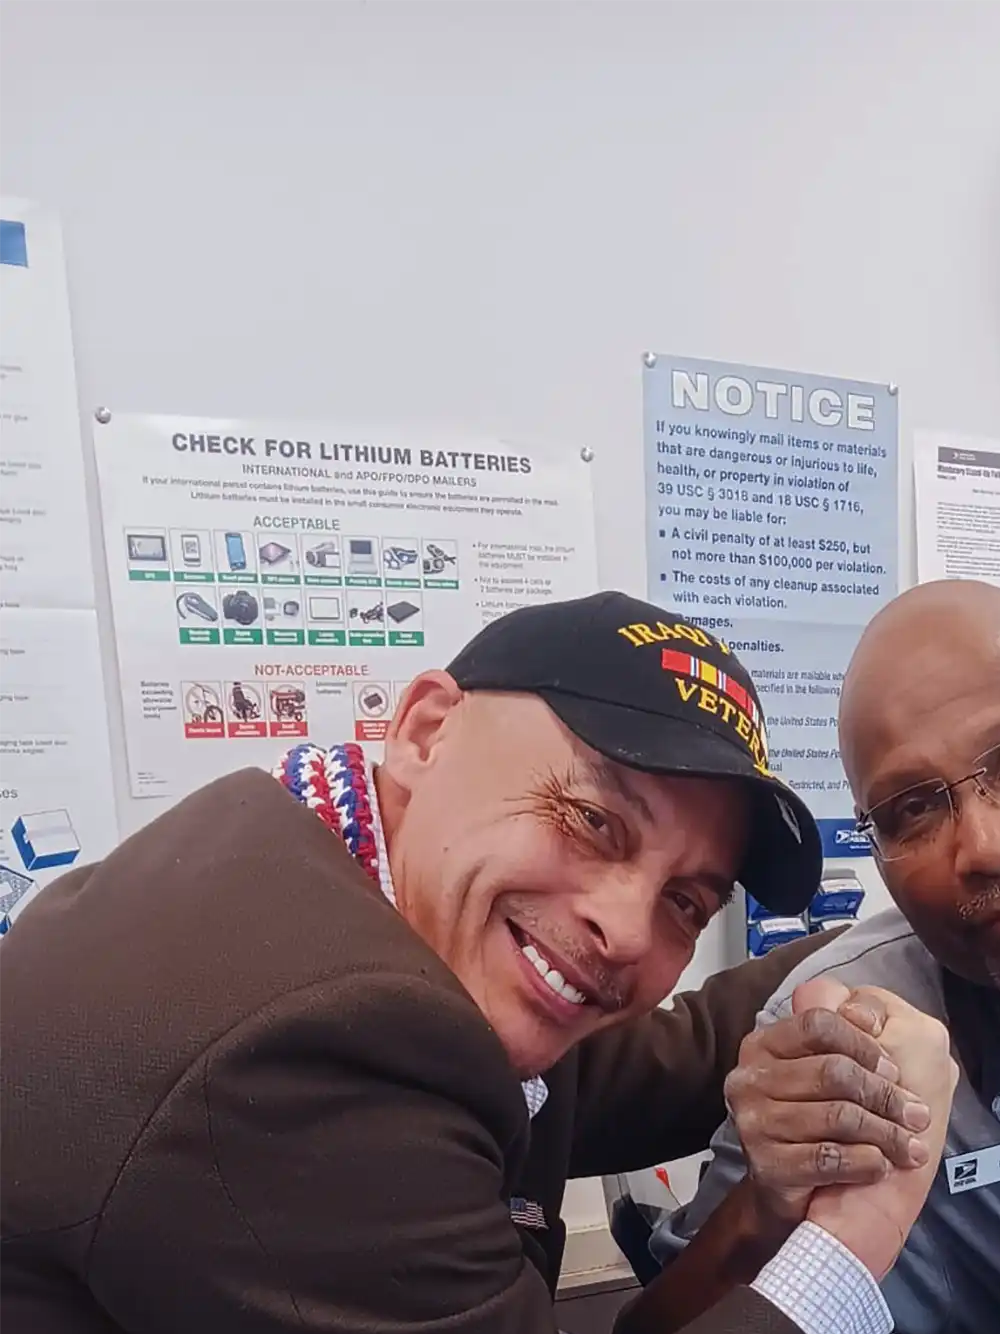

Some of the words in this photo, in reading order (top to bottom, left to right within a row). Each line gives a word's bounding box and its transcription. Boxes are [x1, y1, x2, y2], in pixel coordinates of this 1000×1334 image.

[671, 368, 876, 432] NOTICE
[656, 419, 665, 433] If
[668, 424, 691, 436] you
[694, 424, 756, 445] knowingly
[759, 432, 784, 446] mail
[787, 434, 819, 450] items
[822, 441, 834, 452] or
[836, 443, 886, 458] materials
[172, 432, 256, 456] CHECK
[264, 438, 312, 459] FOR
[319, 442, 411, 465] LITHIUM
[419, 449, 531, 473] BATTERIES
[656, 440, 682, 455] that
[685, 446, 705, 457] are
[709, 446, 772, 464] dangerous
[775, 456, 788, 466] or
[791, 455, 840, 472] injurious
[843, 461, 853, 473] to
[856, 462, 877, 478] life,
[242, 463, 332, 478] INTERNATIONAL
[334, 470, 353, 480] and
[355, 470, 430, 484] APO/FPO/DPO
[432, 475, 476, 487] MAILERS
[657, 460, 699, 480] health,
[703, 468, 716, 479] or
[719, 470, 770, 486] property
[773, 472, 784, 486] in
[787, 475, 835, 491] violation
[837, 480, 849, 492] of
[657, 481, 673, 495] 39
[676, 483, 703, 497] USC
[751, 492, 773, 504] and
[778, 494, 791, 508] 18
[794, 494, 819, 508] USC
[833, 499, 863, 515] 1716,
[253, 515, 340, 531] ACCEPTABLE
[658, 505, 680, 516] you
[684, 507, 709, 520] may
[713, 506, 727, 520] be
[731, 508, 763, 523] liable
[766, 512, 786, 525] for:
[671, 526, 680, 539] A
[683, 528, 708, 541] civil
[711, 532, 755, 547] penalty
[758, 534, 770, 546] of
[773, 536, 784, 547] at
[787, 536, 815, 550] least
[818, 538, 849, 555] $250,
[852, 541, 870, 554] but
[671, 548, 691, 560] not
[695, 551, 725, 562] more
[729, 551, 755, 564] than
[758, 553, 812, 569] $100,000
[815, 560, 834, 572] per
[836, 560, 886, 574] violation.
[672, 569, 695, 583] The
[698, 573, 731, 586] costs
[734, 575, 746, 586] of
[749, 578, 770, 590] any
[773, 577, 817, 594] cleanup
[821, 582, 879, 595] associated
[672, 590, 699, 603] with
[702, 593, 731, 605] each
[734, 594, 787, 608] violation.
[685, 616, 733, 629] amages.
[255, 664, 370, 676] NOT-ACCEPTABLE
